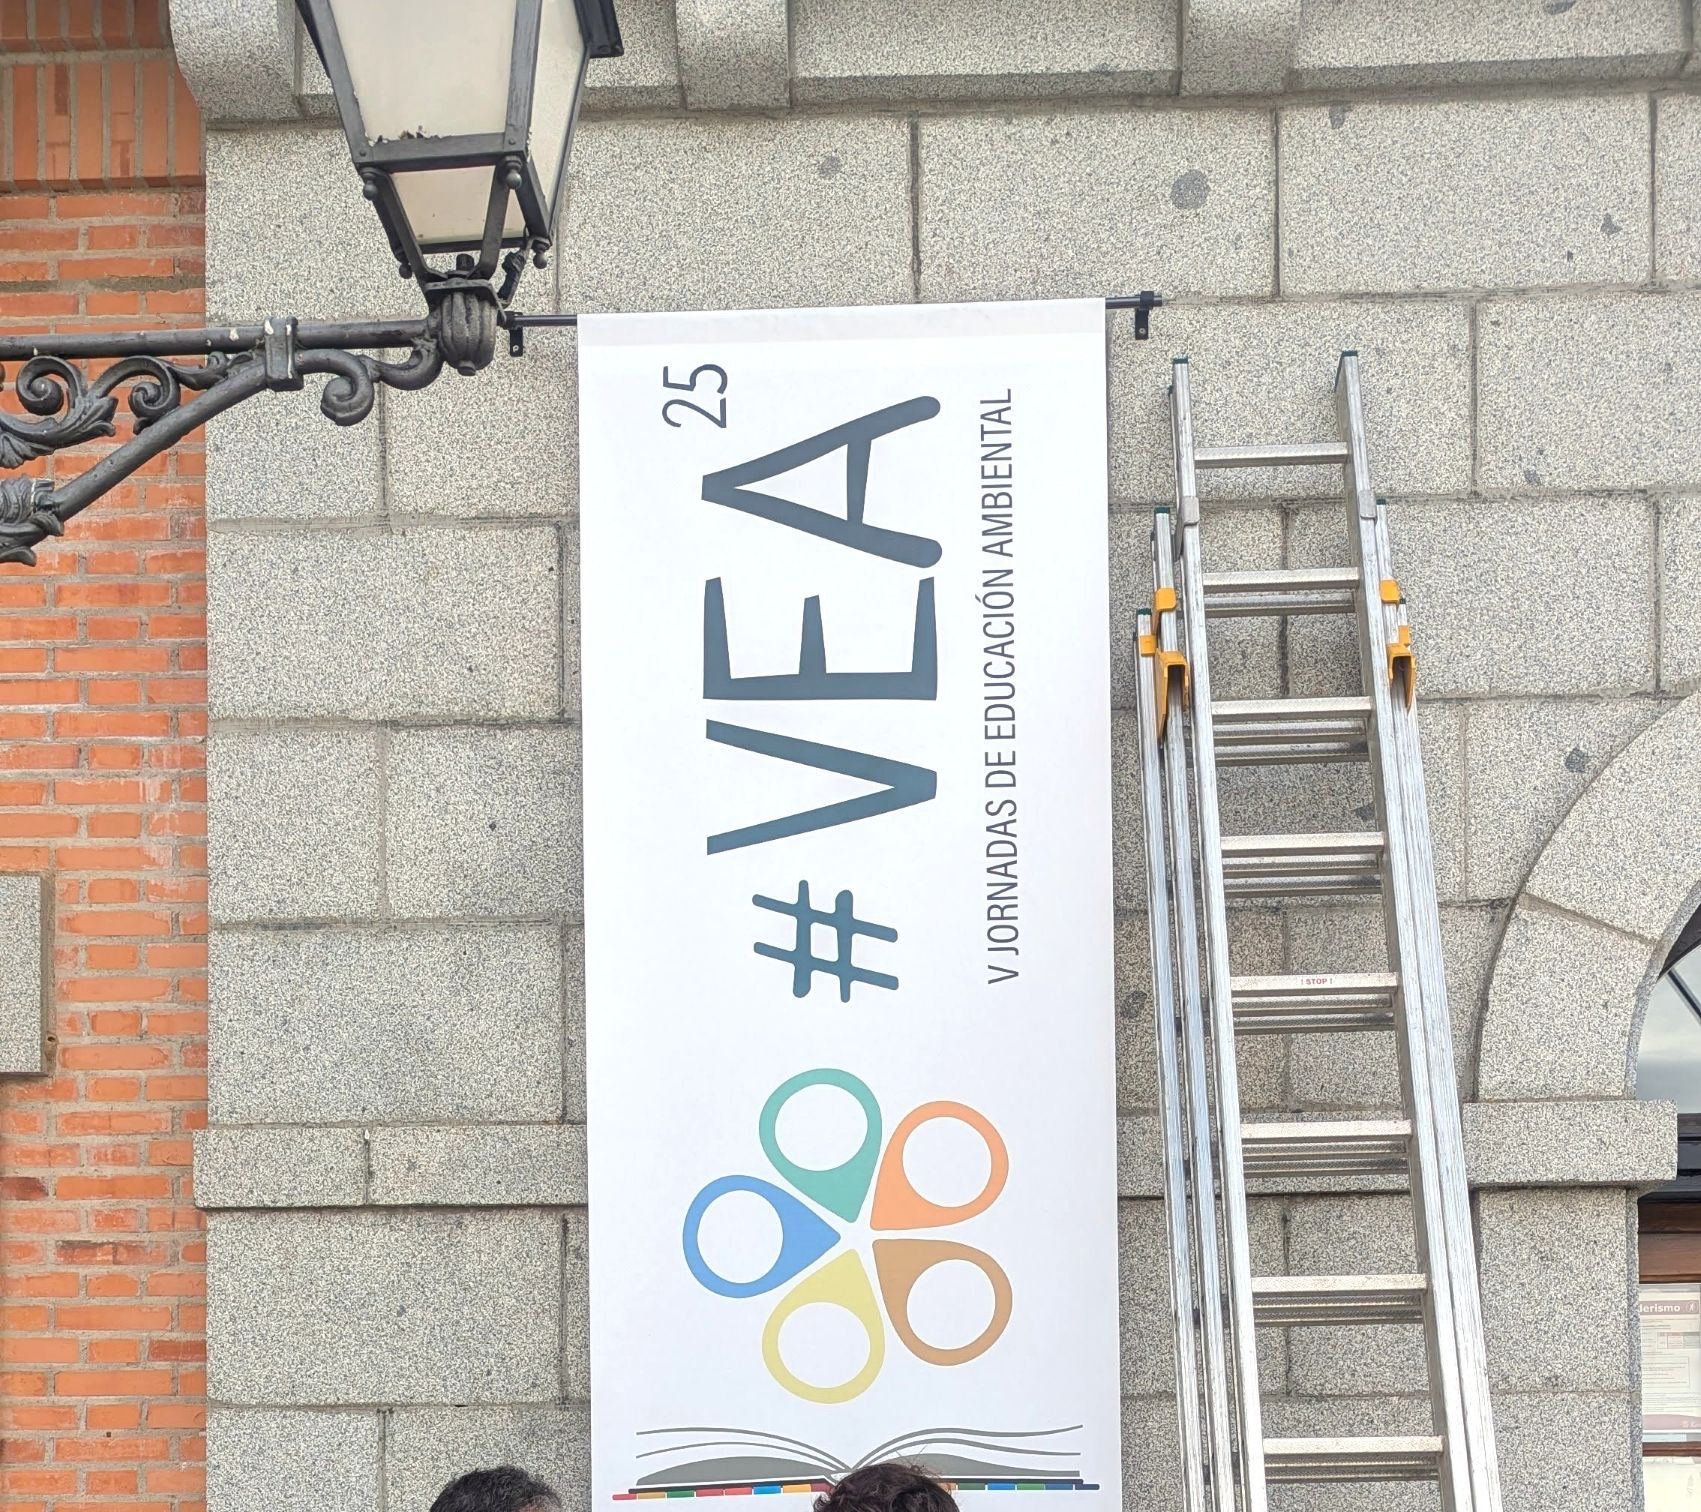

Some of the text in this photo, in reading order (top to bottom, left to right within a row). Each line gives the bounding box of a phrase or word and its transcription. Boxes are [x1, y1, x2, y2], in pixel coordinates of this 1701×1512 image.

[662, 363, 727, 429] 25
[974, 388, 1019, 985] V JORNADAS DE EDUCACIÓN AMBIENTAL
